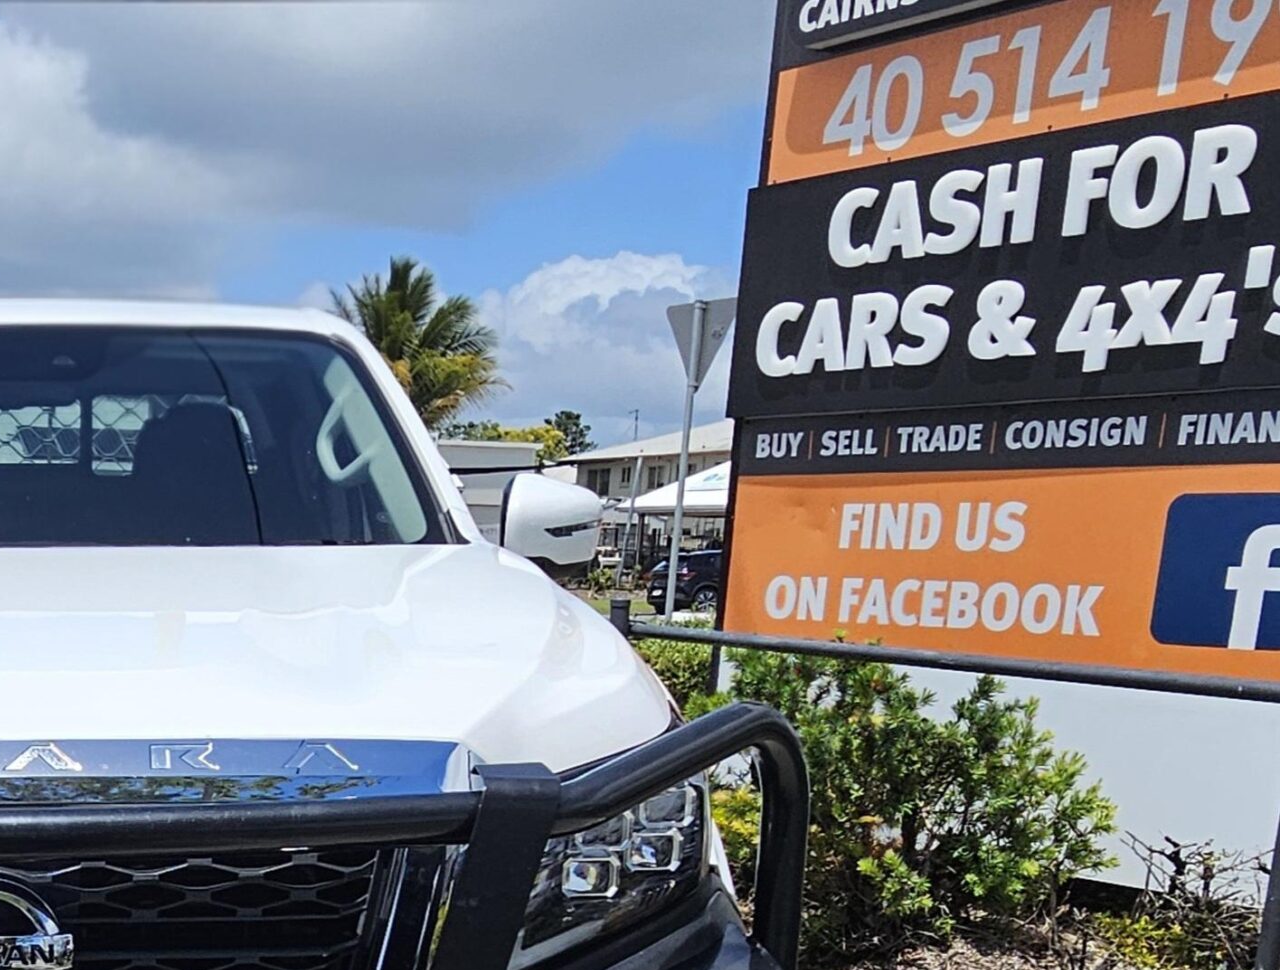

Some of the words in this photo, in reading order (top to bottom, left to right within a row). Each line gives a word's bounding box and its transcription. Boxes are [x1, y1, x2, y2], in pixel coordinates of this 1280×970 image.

[799, 0, 919, 33] CAIR
[822, 54, 924, 157] 40
[940, 5, 1112, 138] 514
[827, 156, 1045, 268] CASH
[1060, 123, 1258, 237] FOR
[755, 284, 955, 378] CARS
[967, 279, 1037, 360] &
[755, 431, 805, 459] BUY
[820, 428, 878, 457] SELL
[896, 422, 984, 454] TRADE
[1004, 415, 1148, 450] CONSIGN
[838, 501, 943, 551] FIND
[954, 501, 1028, 553] US
[764, 575, 828, 622] ON
[838, 577, 1105, 637] FACEBOOK
